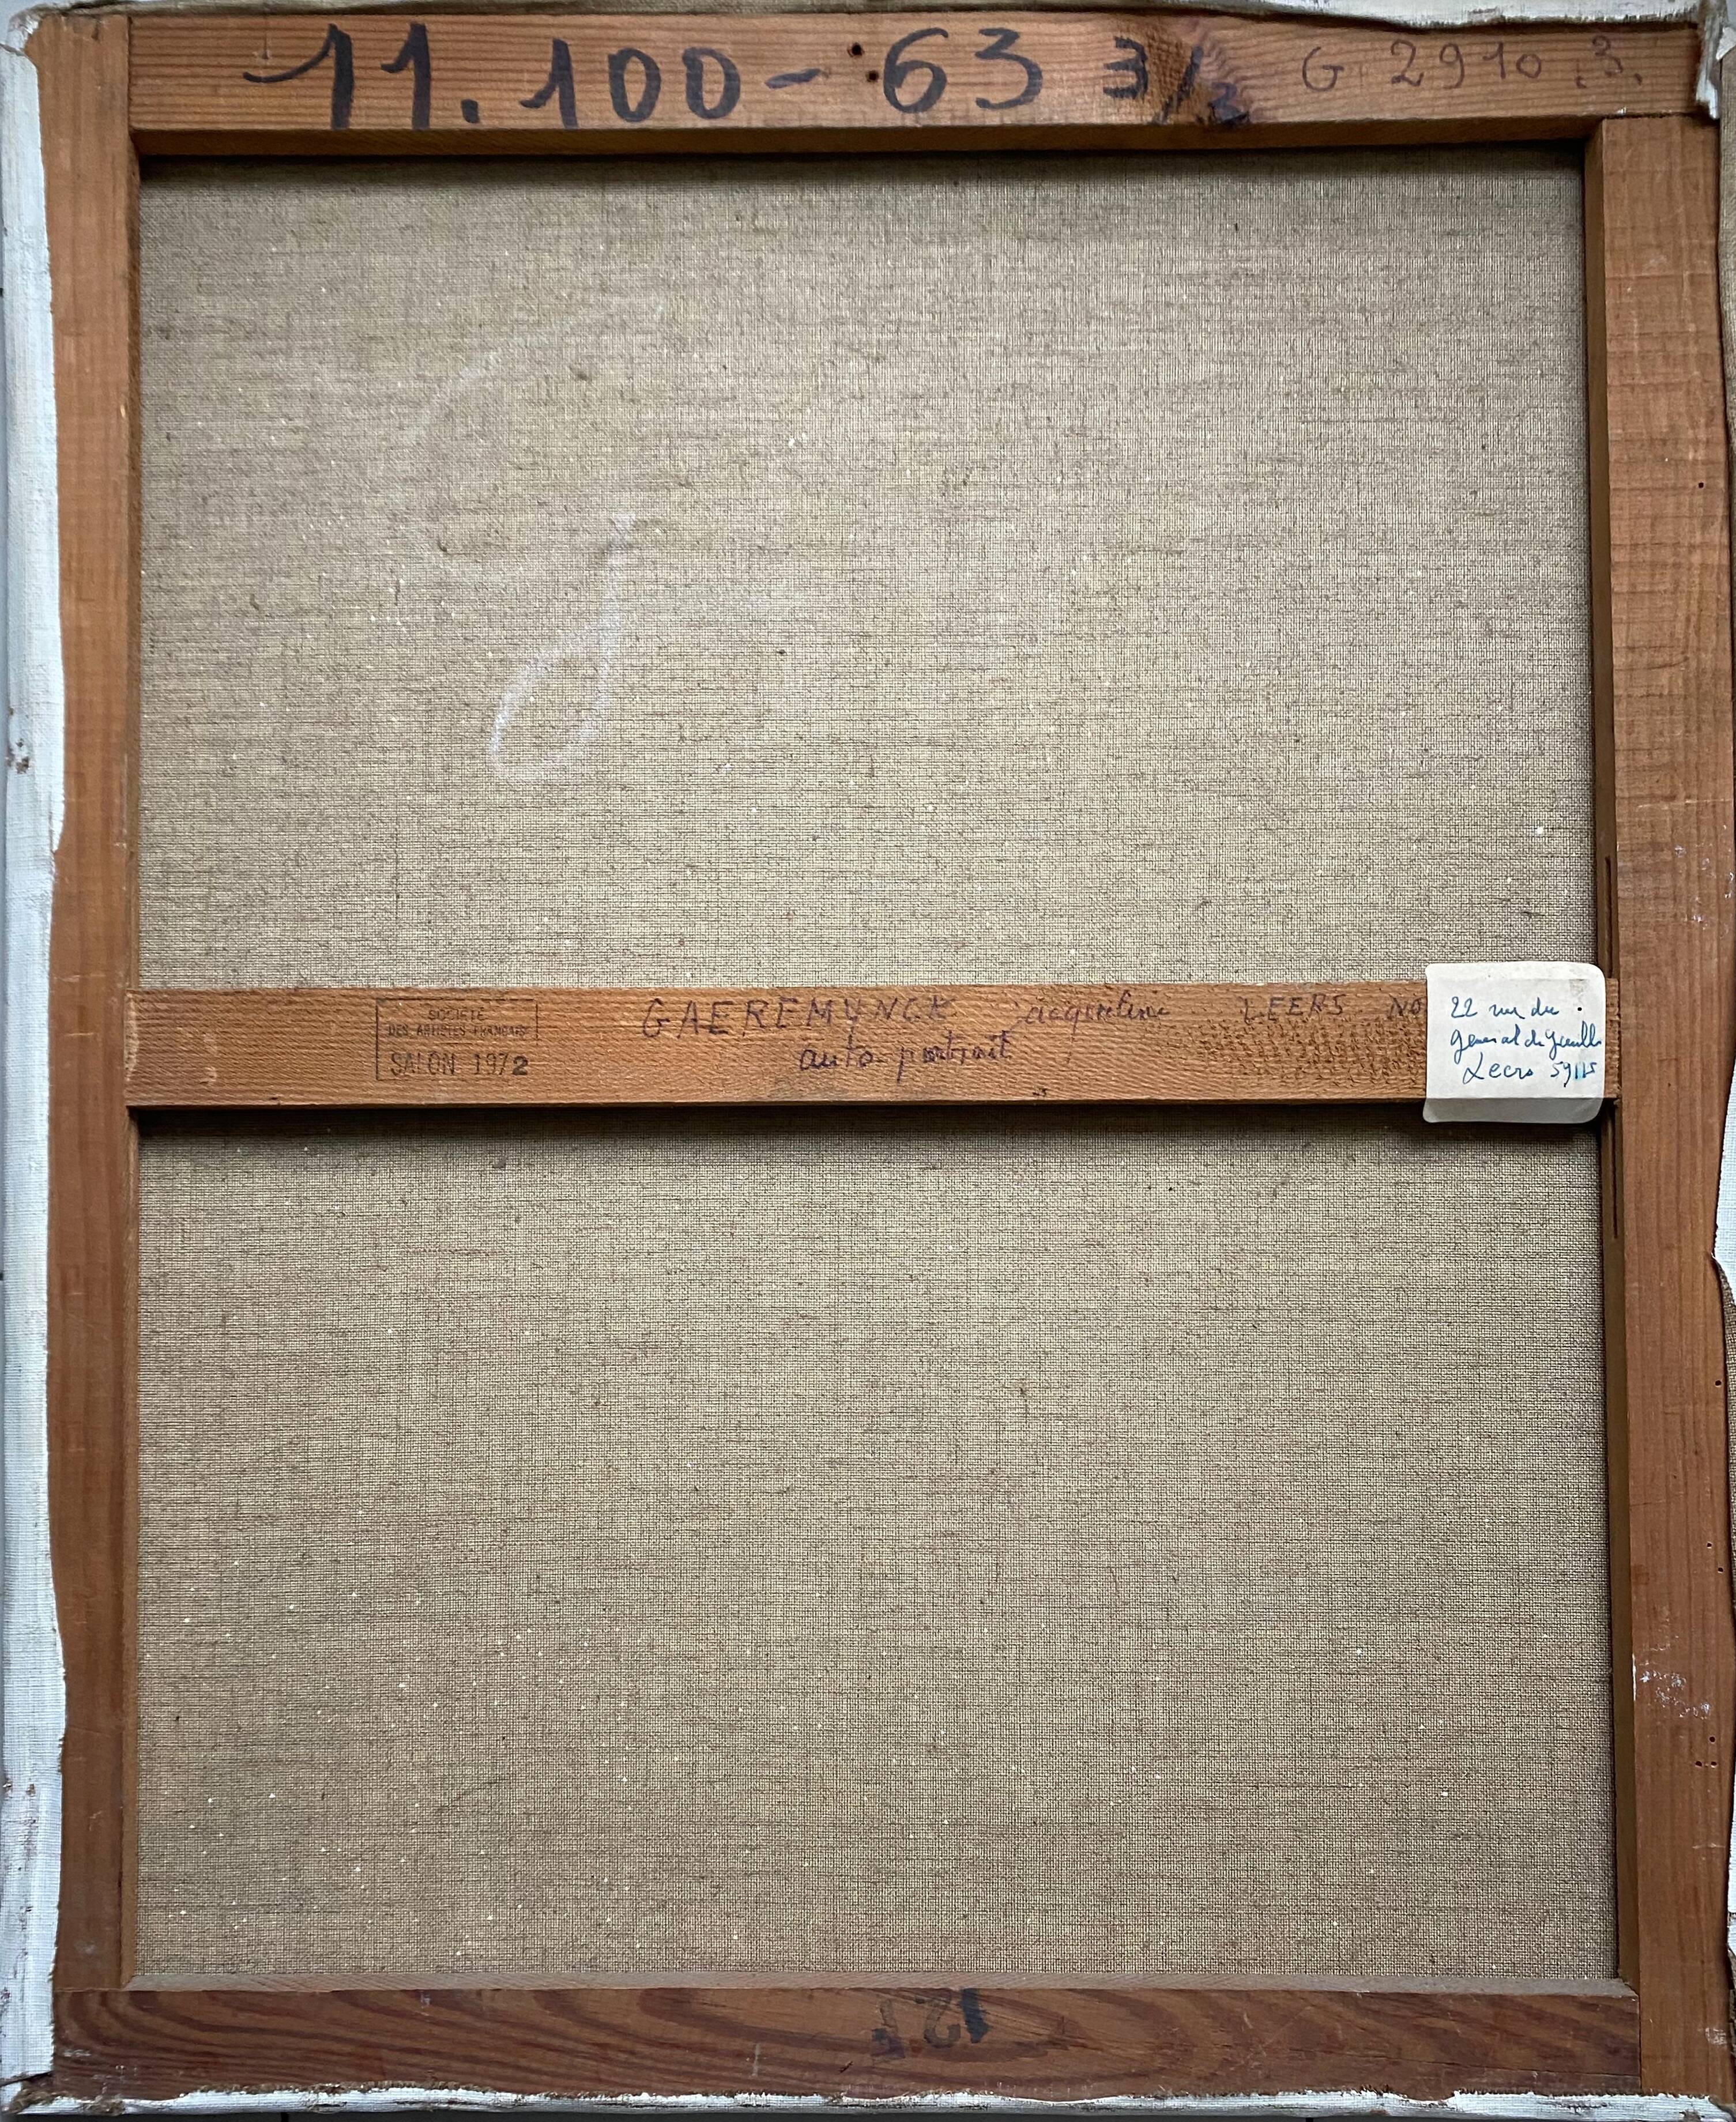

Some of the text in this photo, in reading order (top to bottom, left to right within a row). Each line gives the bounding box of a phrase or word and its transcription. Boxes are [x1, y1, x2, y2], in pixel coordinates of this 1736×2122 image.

[1450, 996, 1478, 1019] 22
[390, 1052, 529, 1077] SALON 1972
